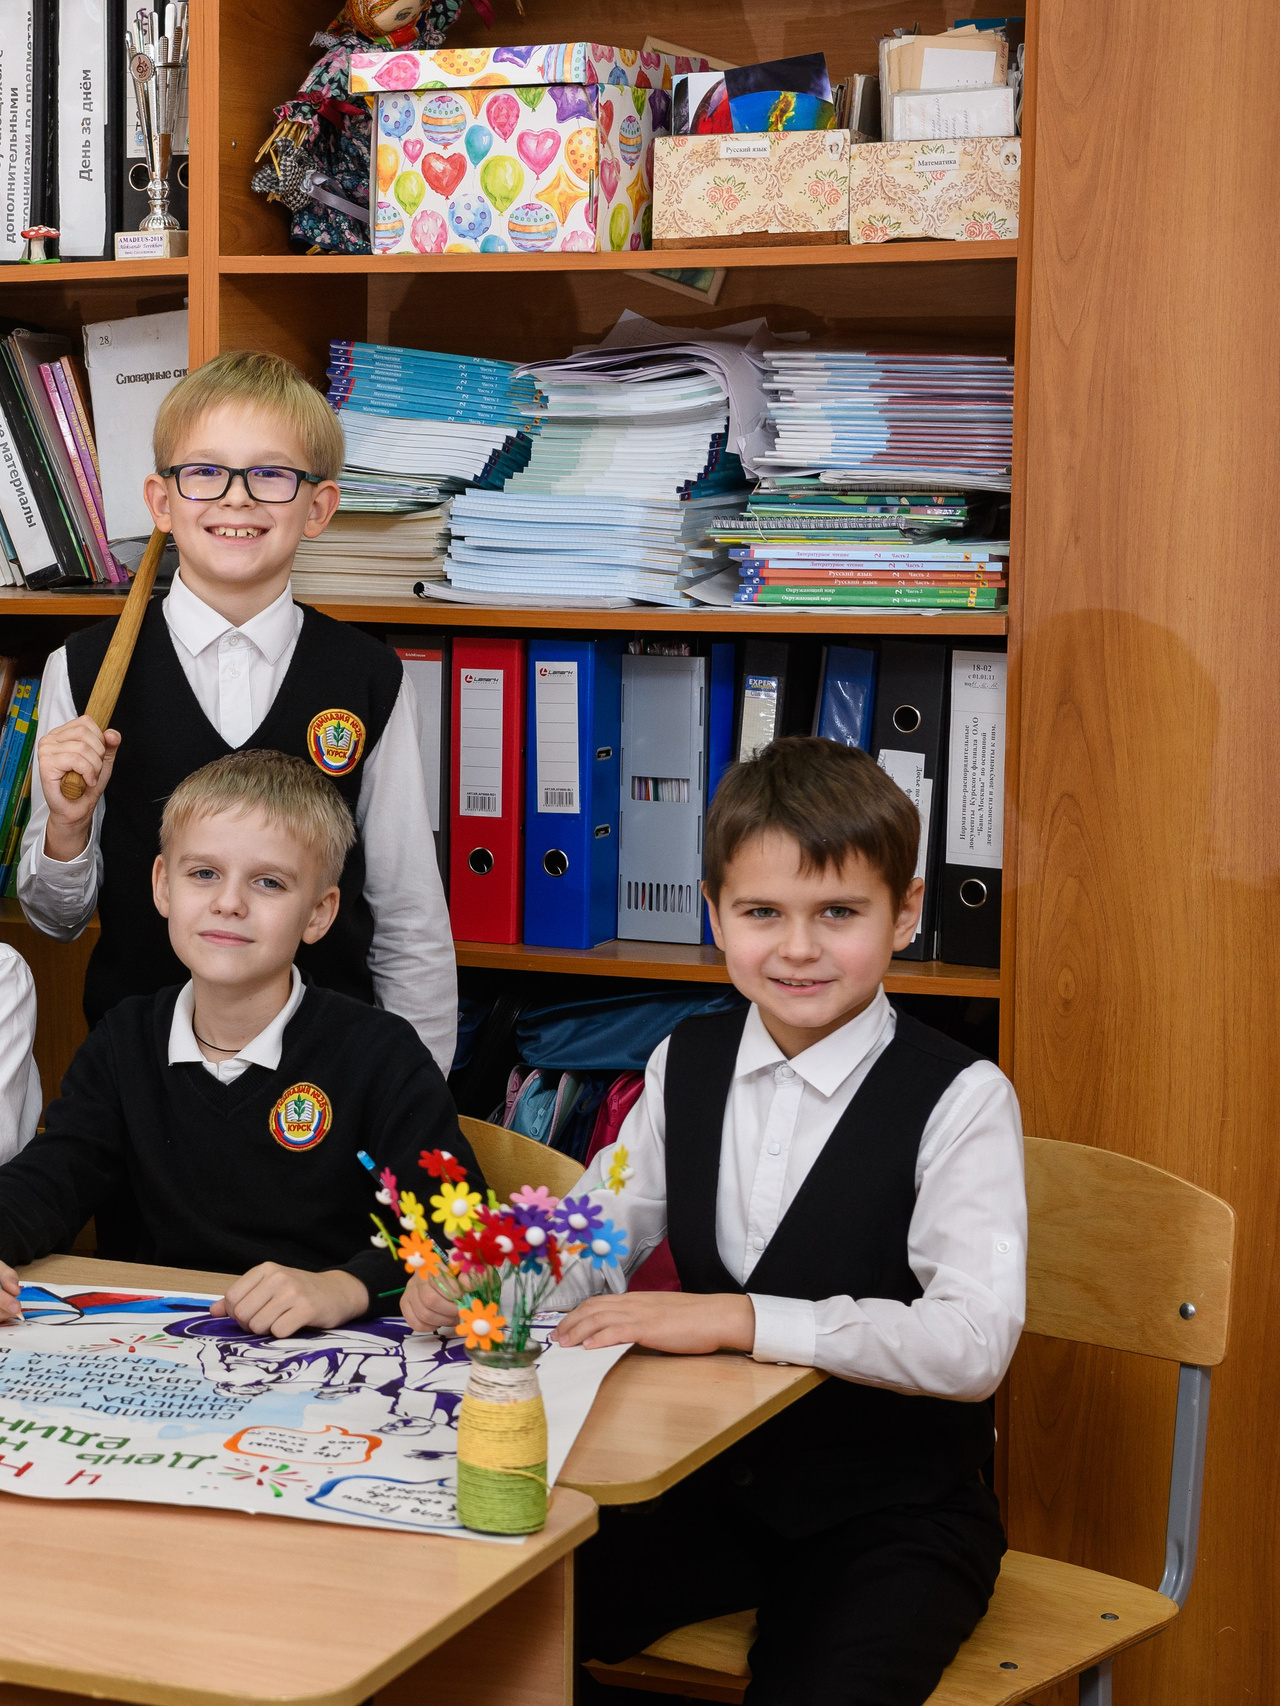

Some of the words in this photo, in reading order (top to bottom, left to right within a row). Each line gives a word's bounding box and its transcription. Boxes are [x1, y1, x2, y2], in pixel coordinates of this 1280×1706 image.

[80, 70, 93, 112] днём
[82, 117, 91, 135] за
[726, 146, 750, 154] Русский
[6, 87, 18, 244] дополнительными
[79, 140, 93, 182] День
[1003, 152, 1018, 166] 33
[98, 336, 110, 346] 28
[374, 354, 400, 362] Математика
[116, 368, 171, 385] Словарные
[377, 383, 404, 391] Математика
[363, 406, 389, 414] Математика
[0, 442, 37, 528] материалы
[87, 500, 101, 532] ОДНОМ
[313, 714, 350, 732] ГИМНАЗИЯ
[326, 749, 348, 758] КУРСК
[980, 767, 986, 776] по
[960, 725, 970, 840] Нормативно-распорядительные
[970, 772, 978, 806] Курского
[916, 789, 920, 797] по
[276, 1086, 311, 1110] ГИМНАЗИЯ
[288, 1124, 312, 1132] КУРСК
[30, 1351, 157, 1365] СМУТНЫХ
[57, 1361, 118, 1370] ГОДУ
[25, 1373, 196, 1392] СОЗДАННЫЙ
[86, 1371, 202, 1385] ИВАНОМ
[102, 1394, 245, 1412] ЕДИНСТВА
[132, 1390, 253, 1403] МИНИНУ
[80, 1401, 236, 1420] СИМВОЛОМ
[75, 1452, 218, 1469] День
